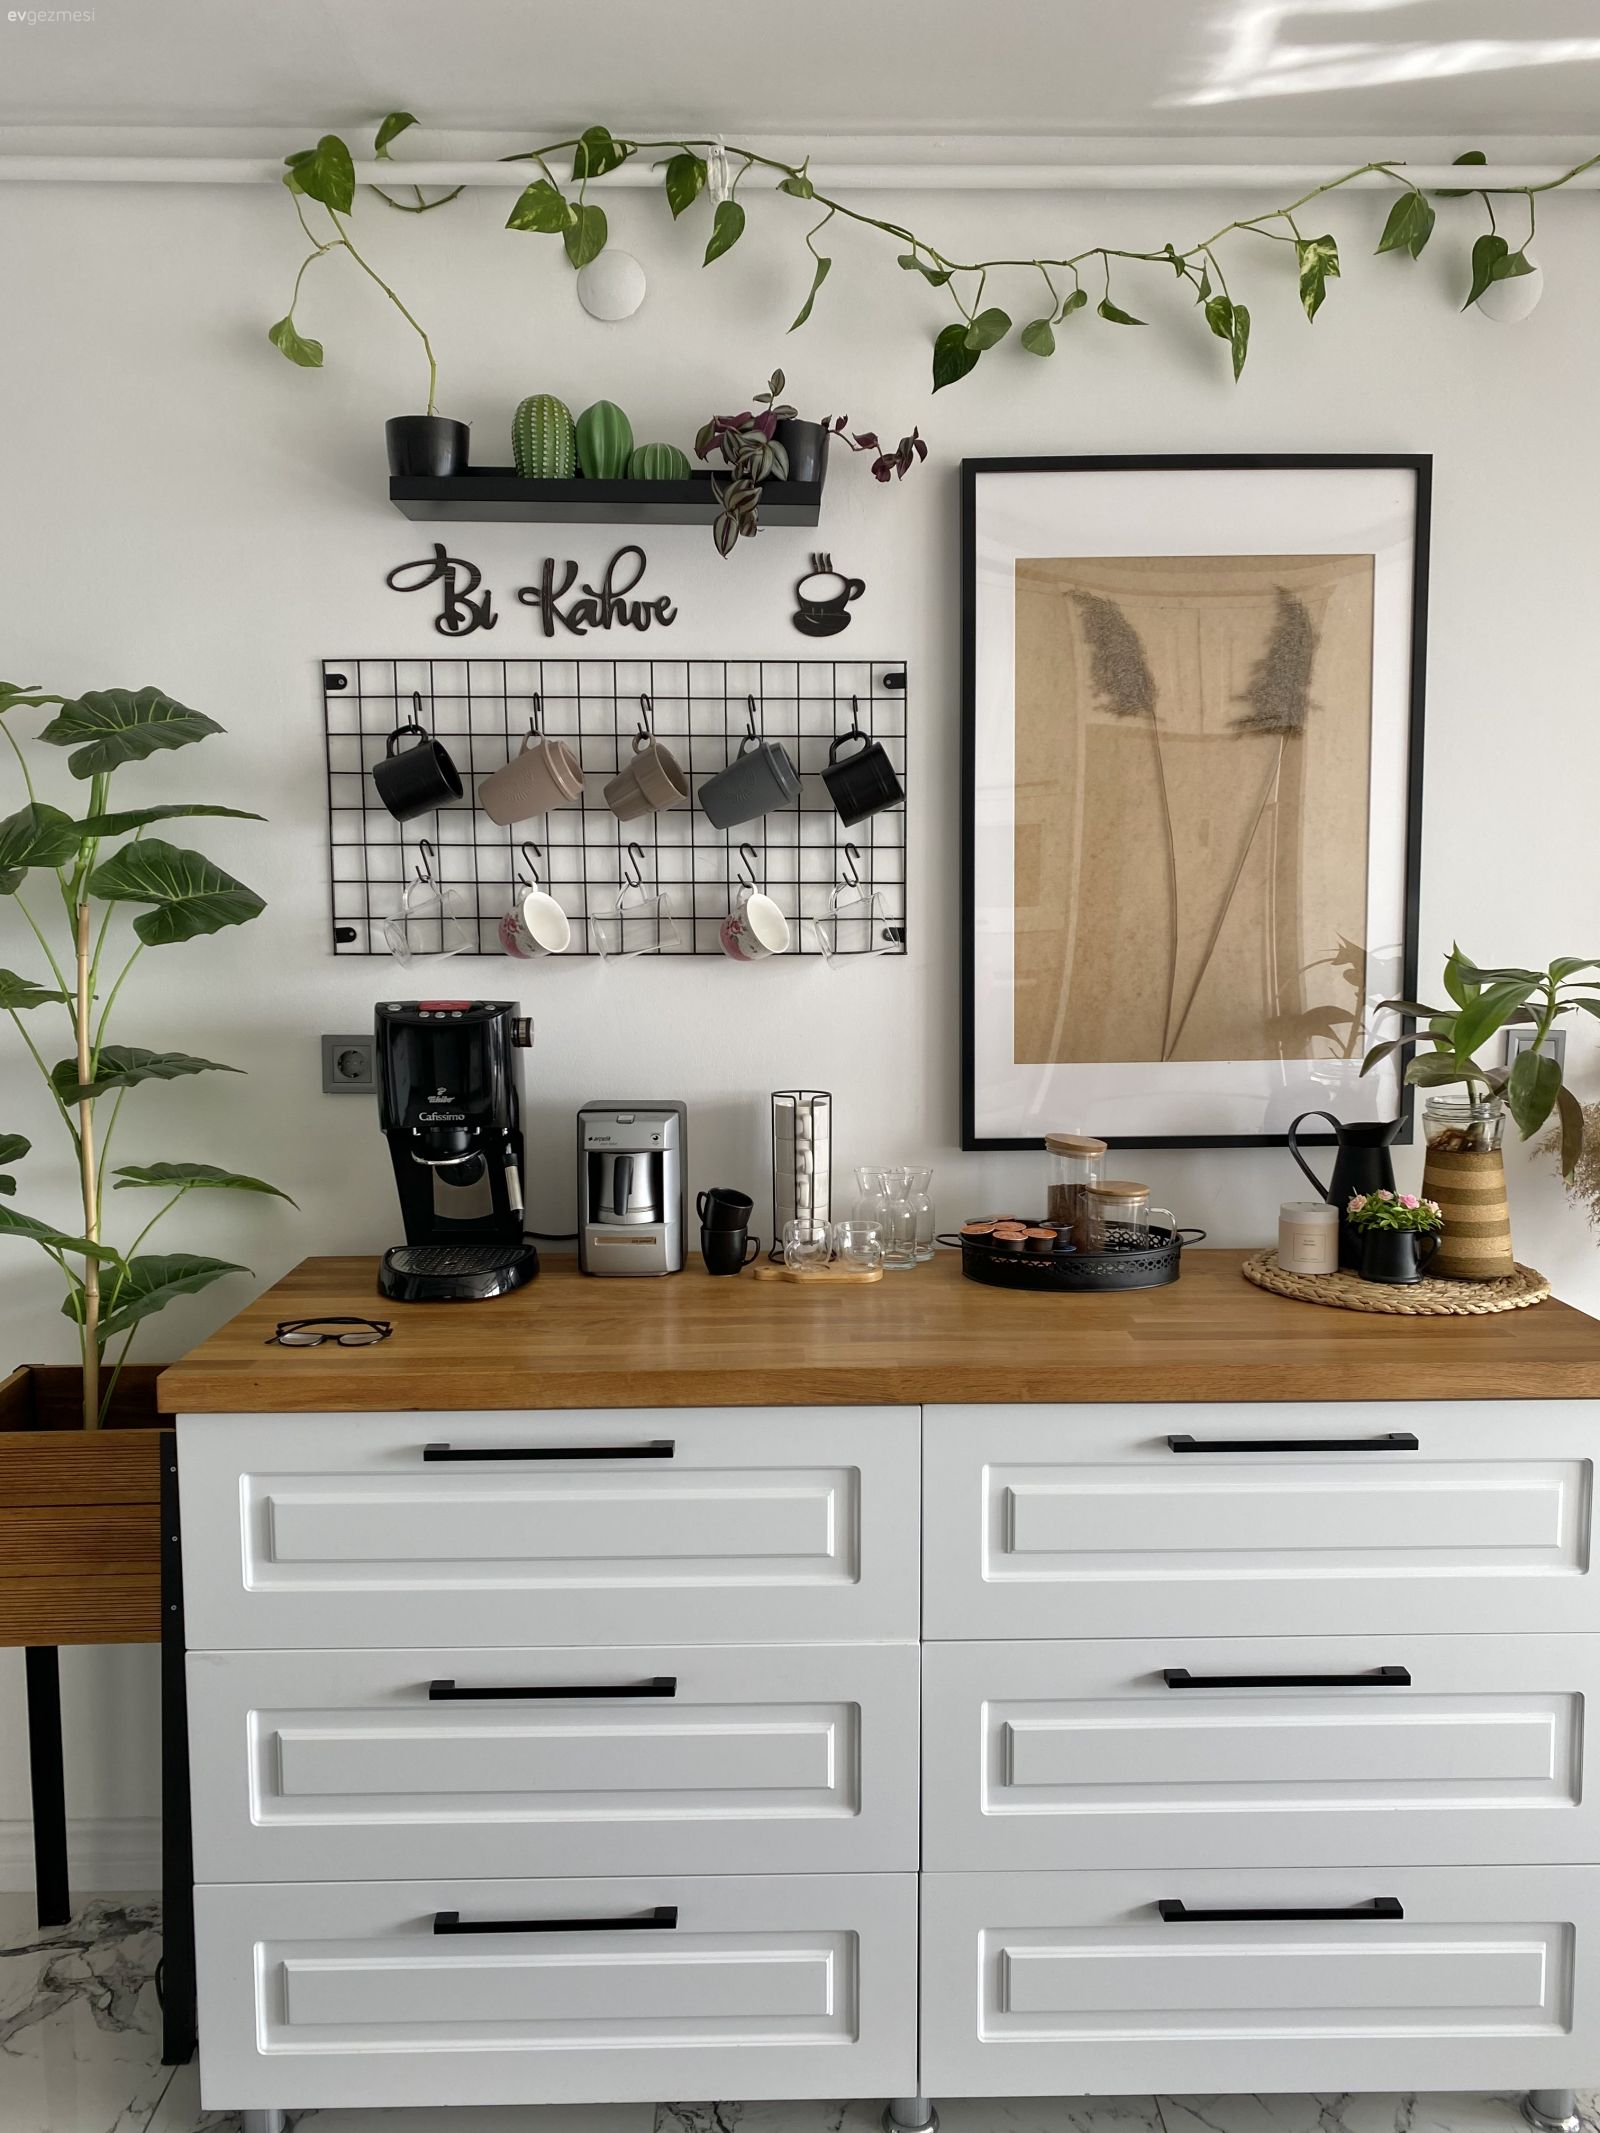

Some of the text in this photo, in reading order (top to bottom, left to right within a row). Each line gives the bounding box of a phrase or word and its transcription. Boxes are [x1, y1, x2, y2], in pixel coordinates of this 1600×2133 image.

[387, 543, 678, 637] Bi Kahve
[418, 1111, 466, 1121] Cafissimo
